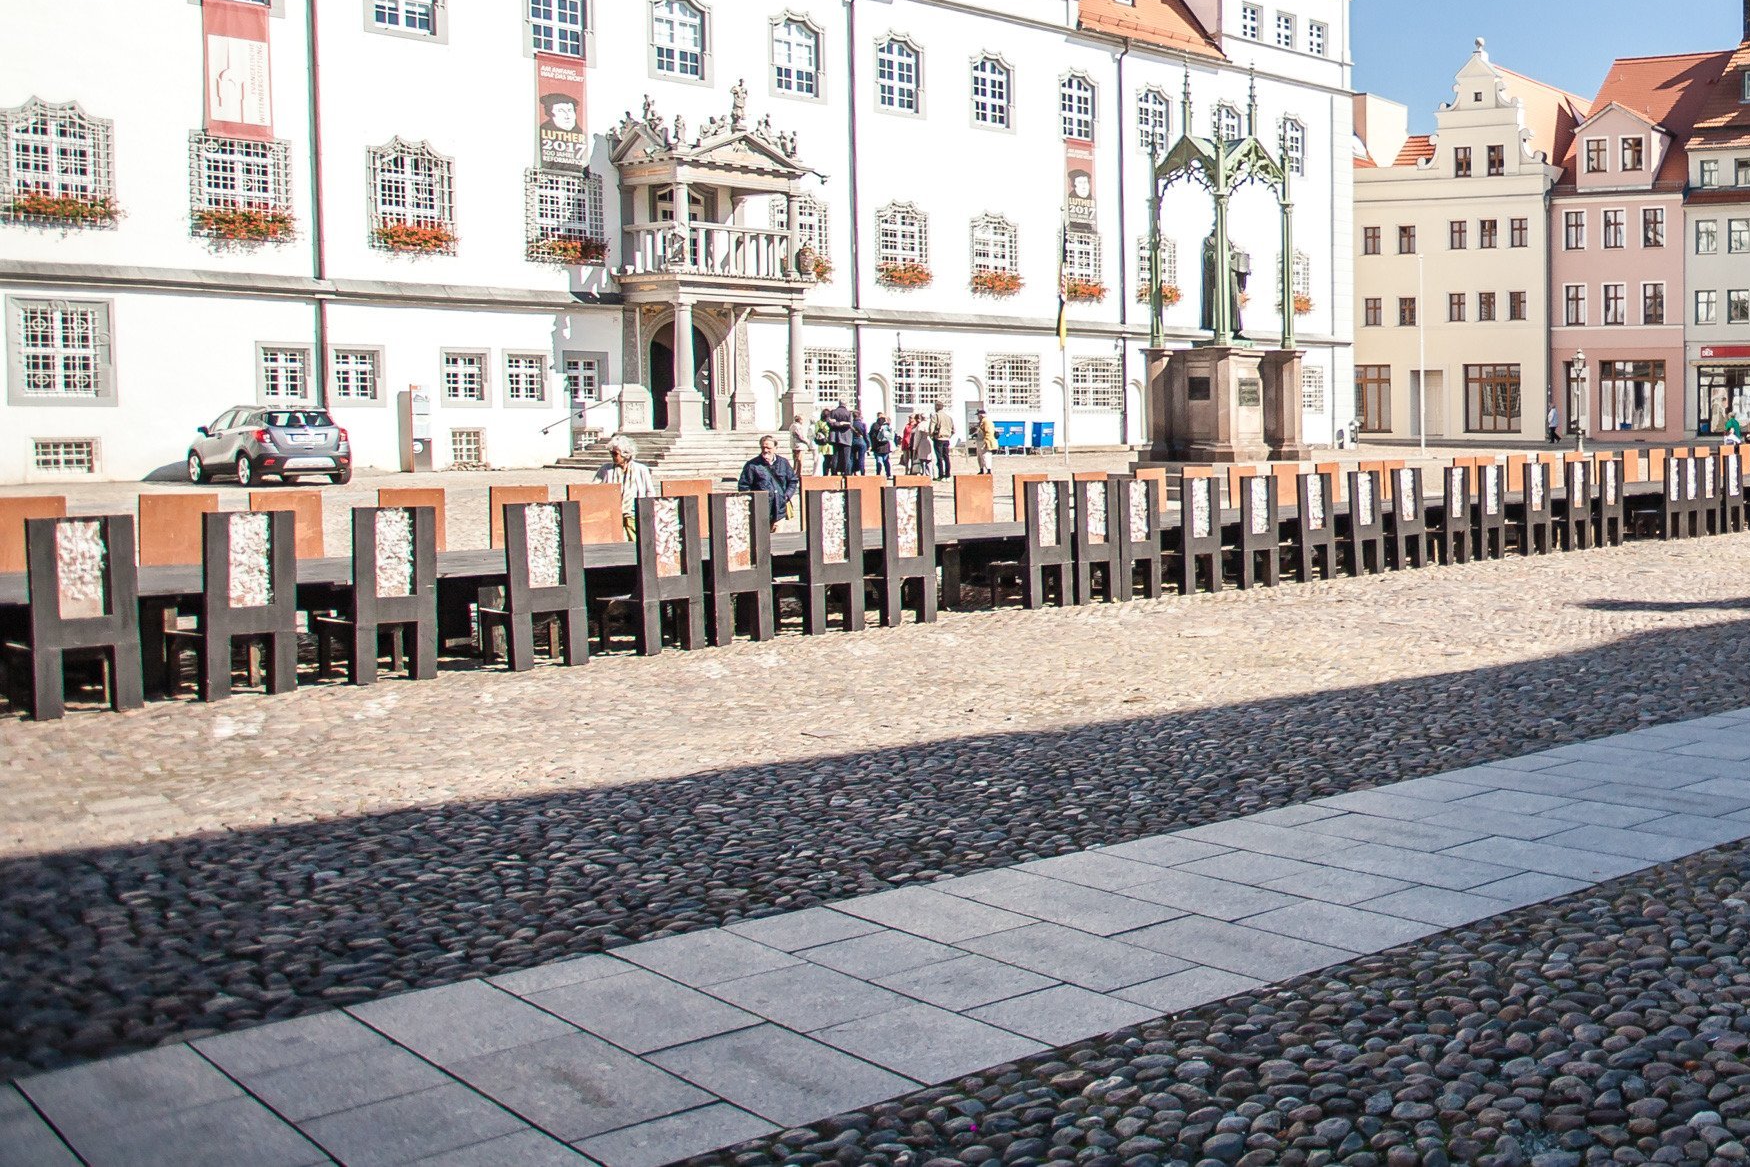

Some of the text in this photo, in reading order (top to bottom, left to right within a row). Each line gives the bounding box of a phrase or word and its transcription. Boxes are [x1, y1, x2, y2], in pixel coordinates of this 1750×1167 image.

[542, 130, 586, 144] LUTHER
[542, 140, 587, 159] 2017
[1068, 197, 1095, 208] LUTHER
[1069, 205, 1096, 220] 2017
